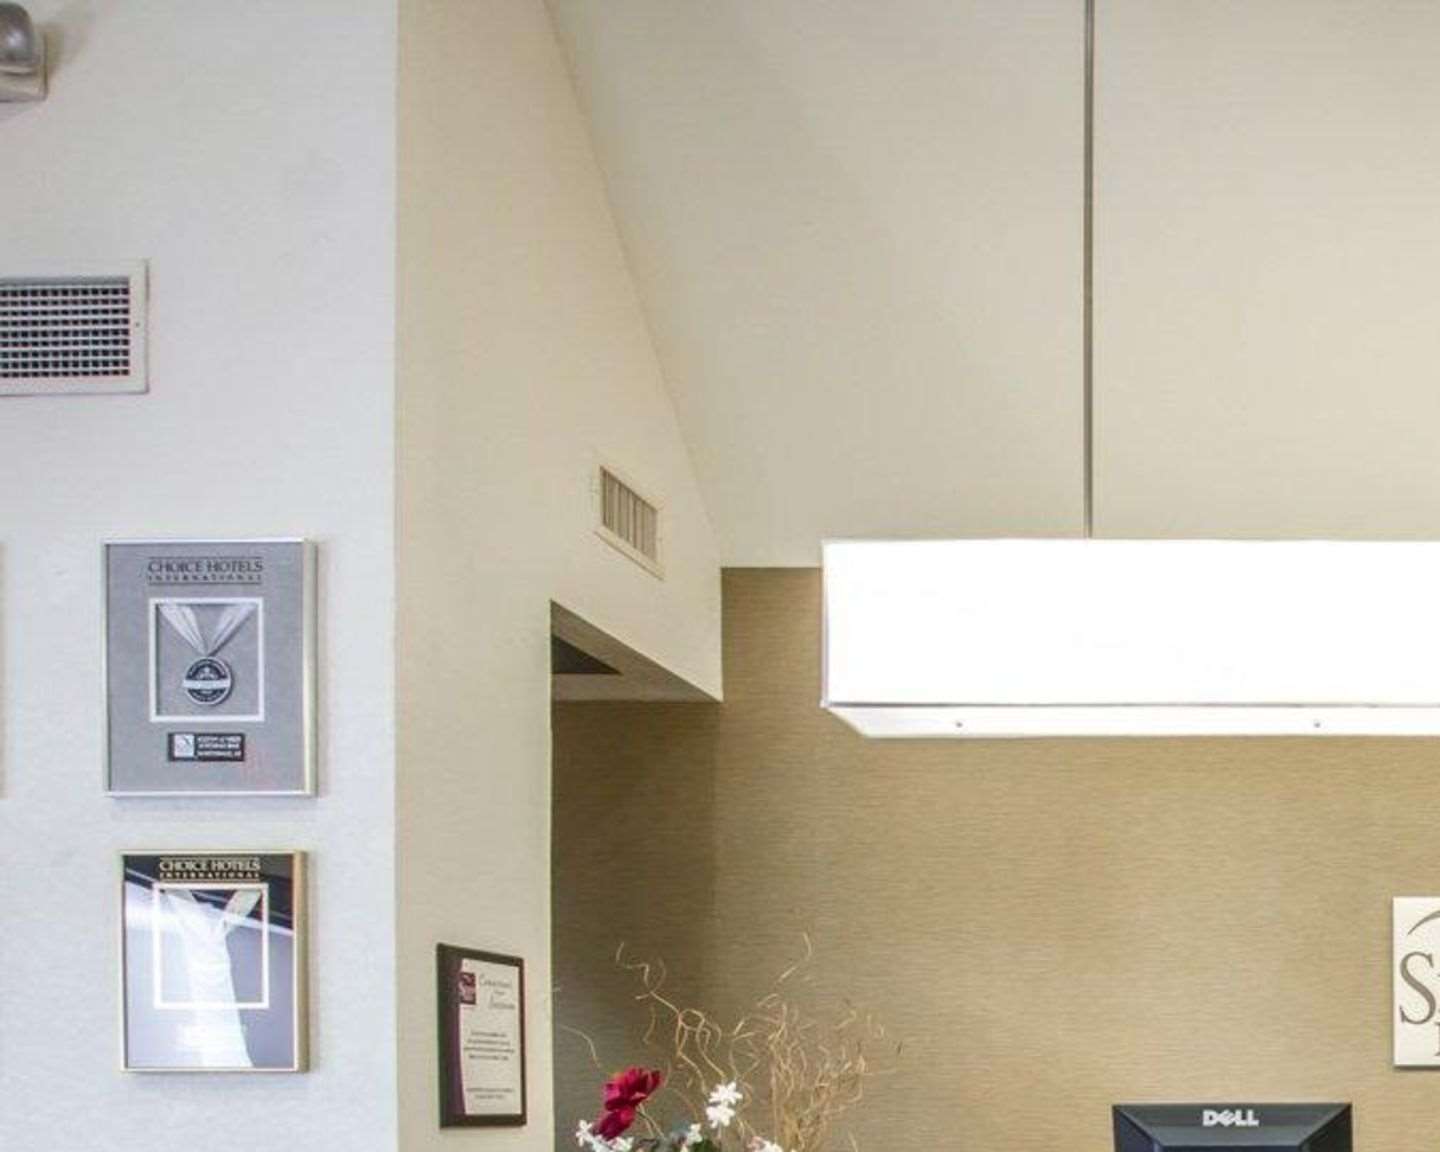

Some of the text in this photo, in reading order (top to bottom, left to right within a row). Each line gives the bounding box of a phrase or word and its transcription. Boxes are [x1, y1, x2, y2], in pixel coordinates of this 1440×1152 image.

[148, 558, 264, 573] CHOICE HOTELS
[159, 858, 261, 872] CHOICE HOTELS
[1202, 1109, 1259, 1127] DELL
